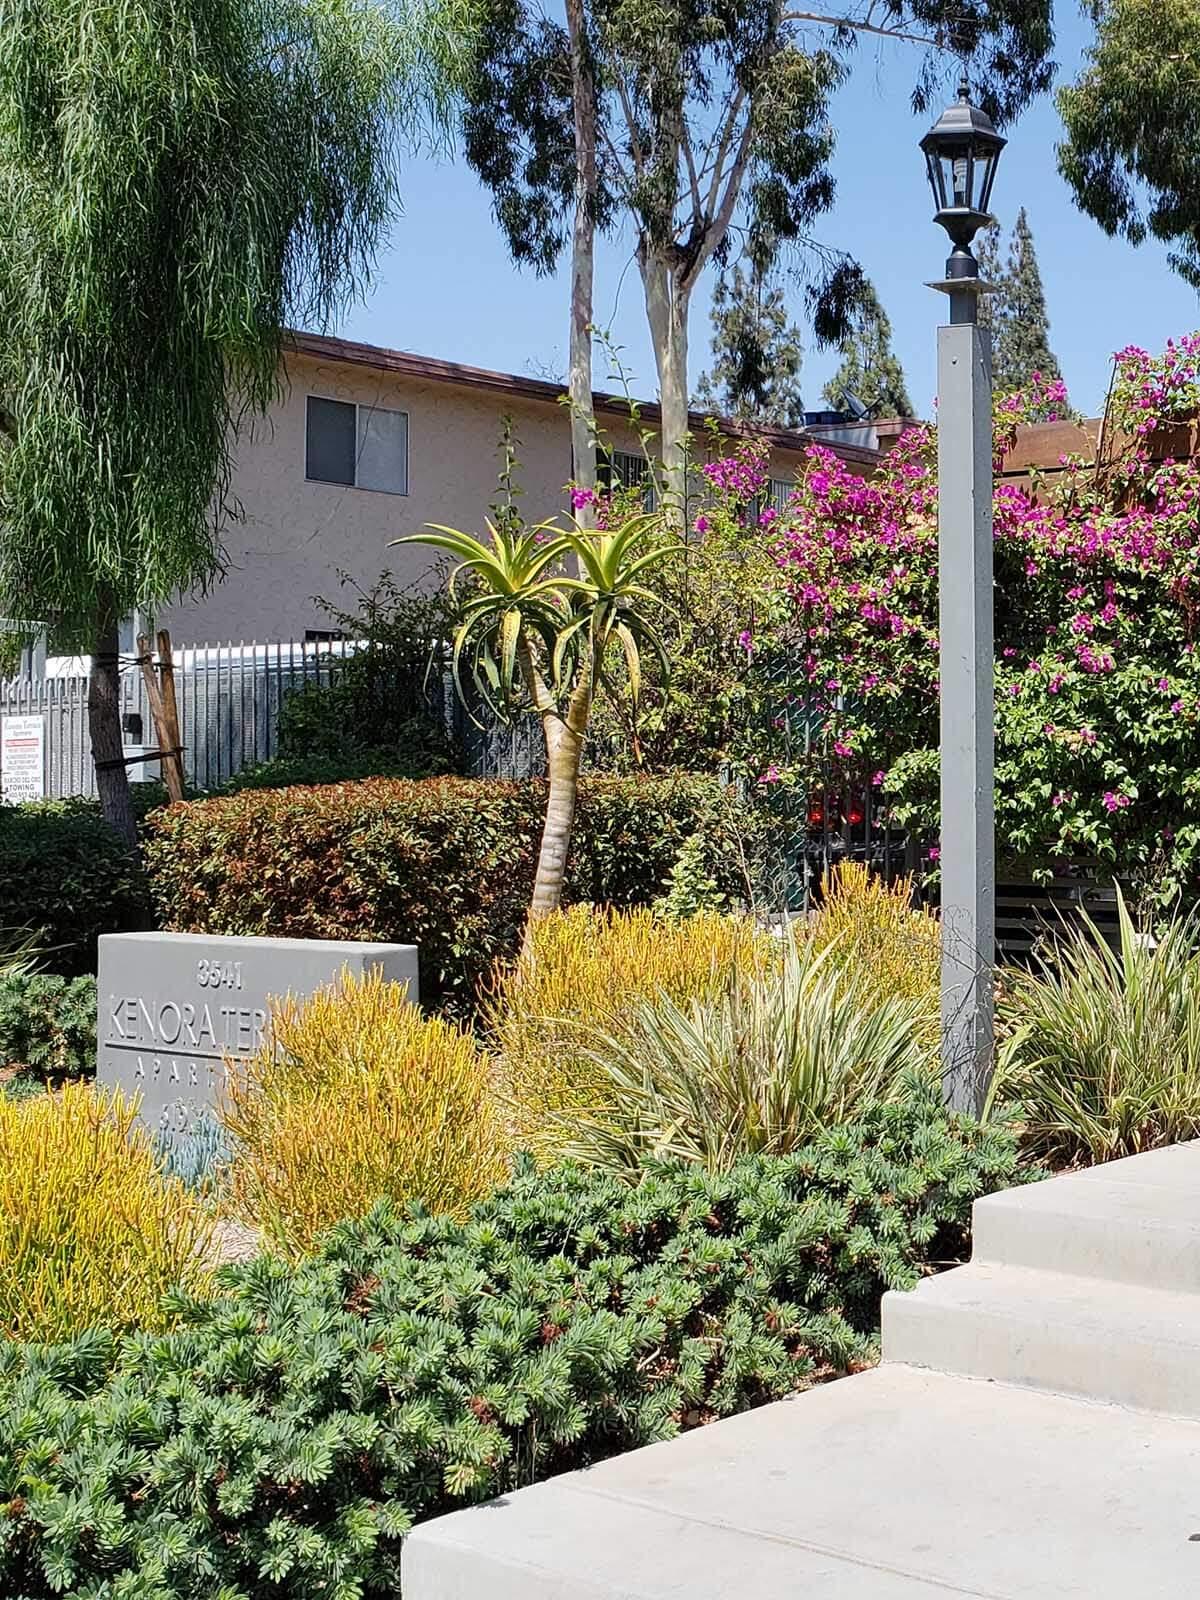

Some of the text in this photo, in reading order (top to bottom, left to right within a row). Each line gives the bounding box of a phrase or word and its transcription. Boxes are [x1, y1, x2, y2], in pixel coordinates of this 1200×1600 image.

[197, 959, 243, 989] 3541
[109, 995, 268, 1053] KENORA TER
[134, 1055, 230, 1089] APART
